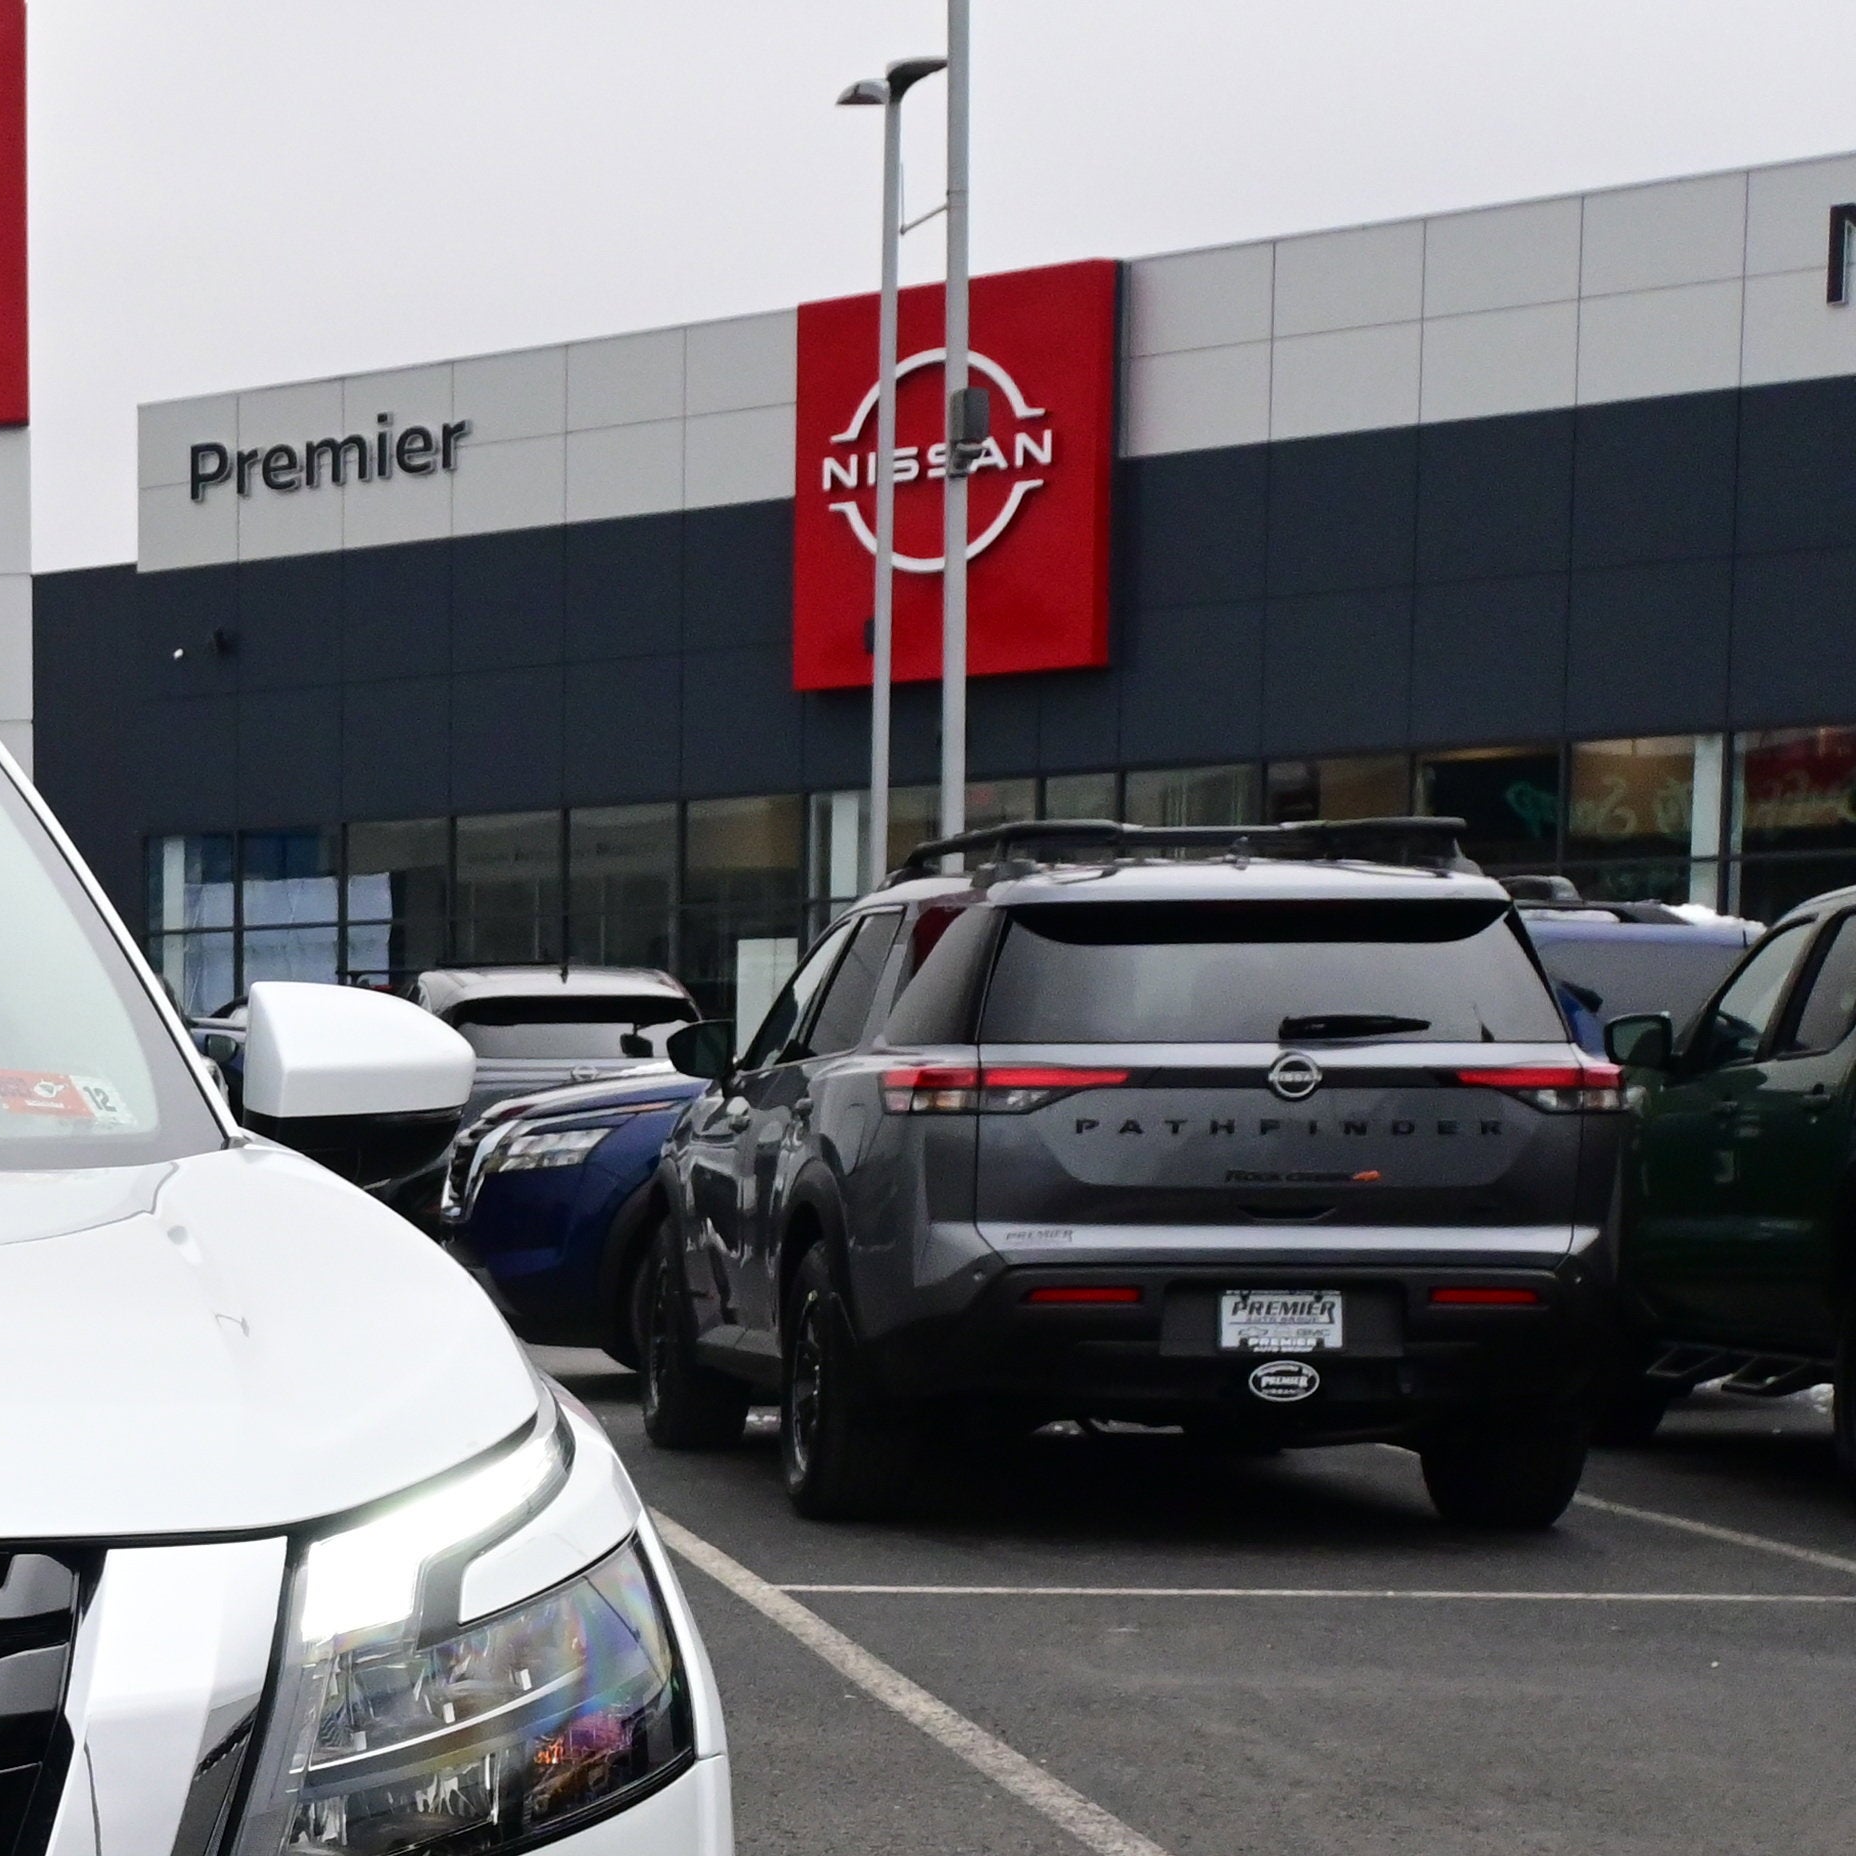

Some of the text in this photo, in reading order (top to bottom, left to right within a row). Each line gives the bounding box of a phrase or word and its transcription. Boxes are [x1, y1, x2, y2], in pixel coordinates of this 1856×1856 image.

[190, 412, 470, 501] Premier
[1075, 1118, 1504, 1136] PATHFINDER
[1231, 1301, 1336, 1325] PREMIER
[1247, 1337, 1318, 1347] PREMIER
